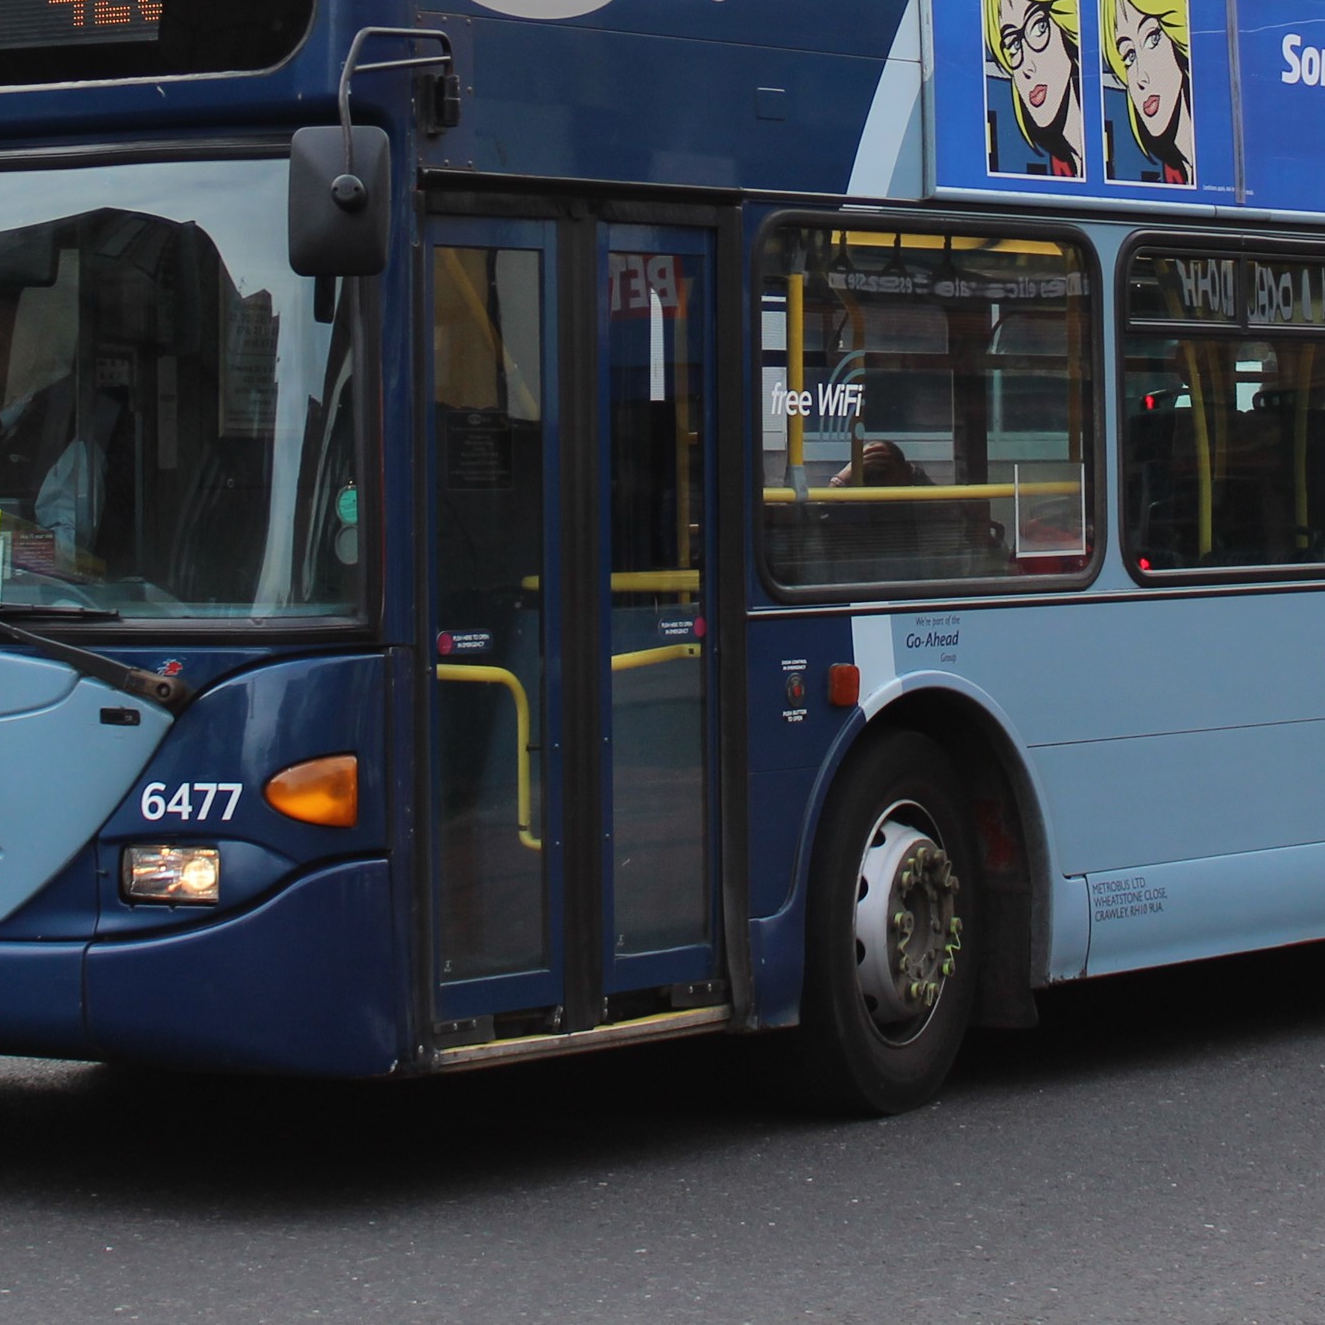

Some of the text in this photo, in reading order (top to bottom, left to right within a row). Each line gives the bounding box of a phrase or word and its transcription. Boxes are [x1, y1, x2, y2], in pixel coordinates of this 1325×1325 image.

[771, 381, 863, 417] free WiFi
[916, 615, 960, 628] We're part of the
[906, 630, 960, 649] Go-Ahead
[940, 652, 957, 663] Group
[141, 782, 243, 821] 6477
[1092, 880, 1130, 895] METROBUS
[1094, 891, 1142, 908] WHEATSTONE
[1131, 904, 1148, 917] RH10
